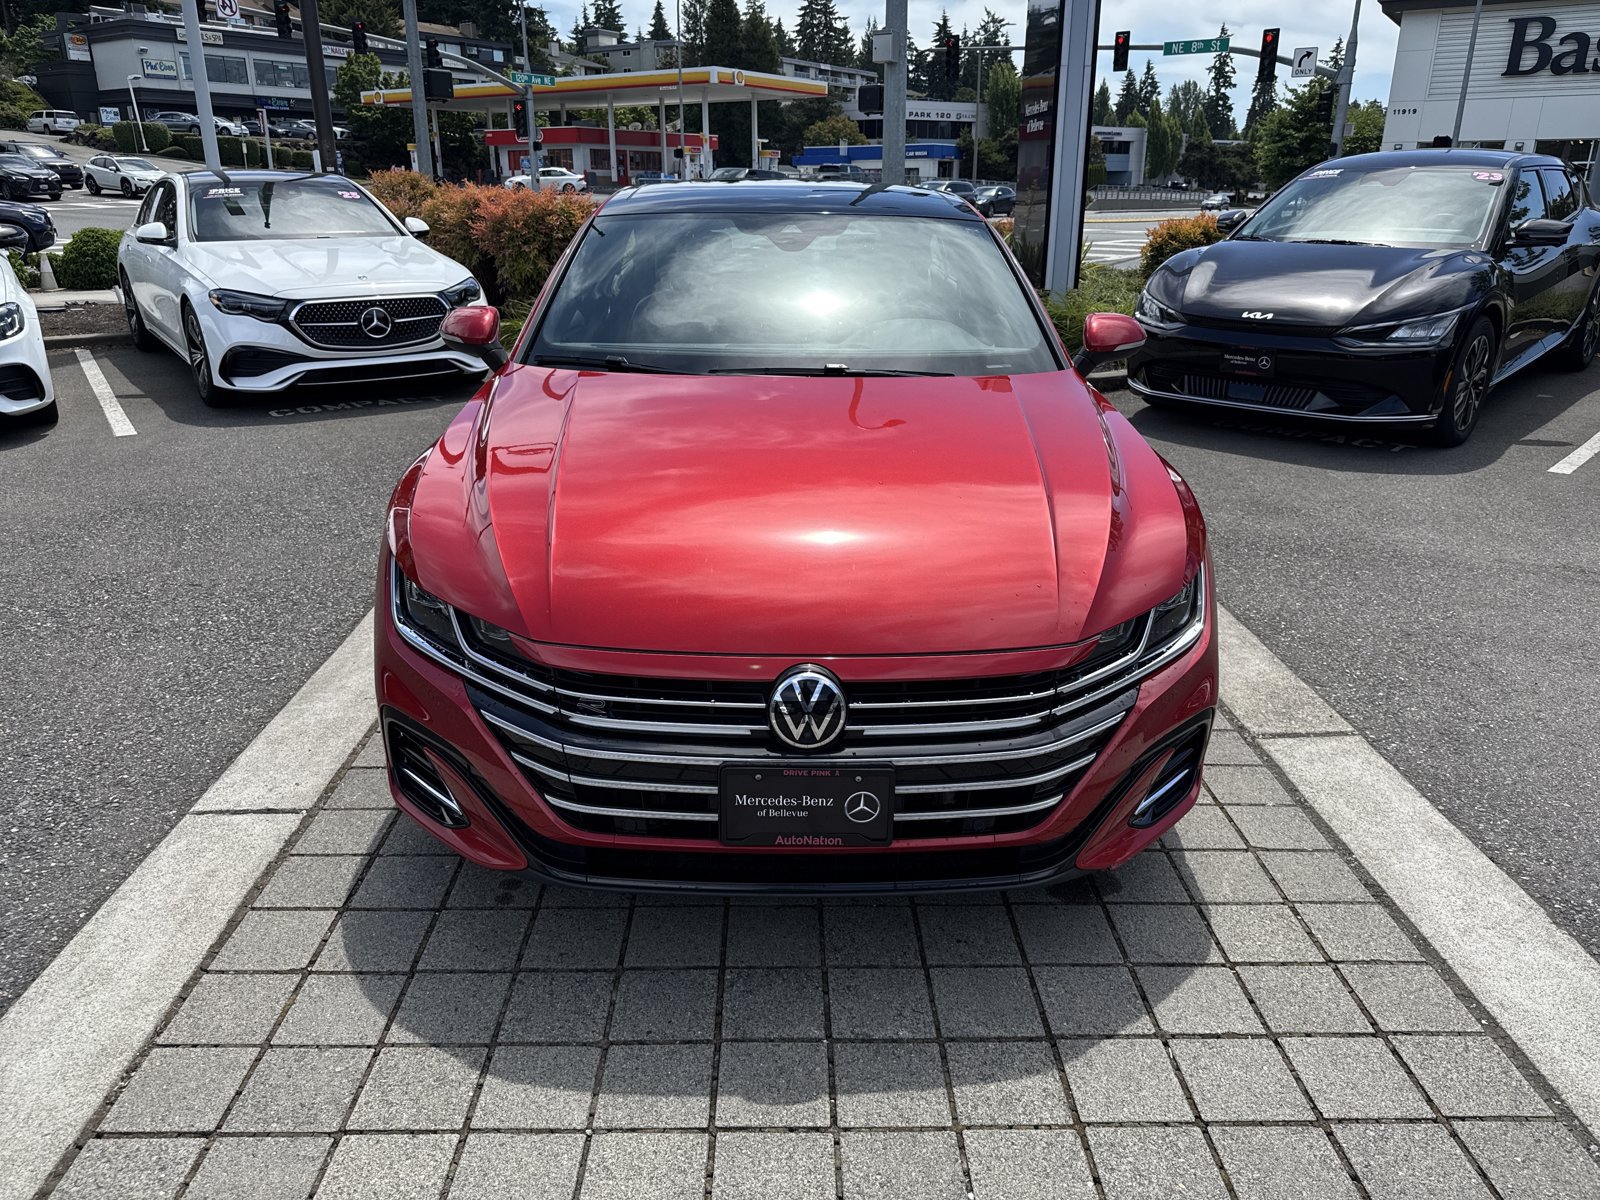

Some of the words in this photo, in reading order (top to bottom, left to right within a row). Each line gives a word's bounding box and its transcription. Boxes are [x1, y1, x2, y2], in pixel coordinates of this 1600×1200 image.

[331, 47, 345, 55] NAILS
[1172, 43, 1184, 54] NE
[1191, 42, 1204, 53] 8th
[1210, 40, 1221, 51] St
[515, 74, 528, 82] 120th
[531, 75, 541, 84] Ave
[544, 76, 552, 85] NE
[1472, 171, 1503, 181] '23
[1224, 353, 1256, 363] Mercedes-Benz
[268, 395, 443, 418] COMPACT
[735, 794, 834, 807] Mercedes-Benz
[757, 809, 767, 817] of
[769, 808, 809, 818] Bellevue
[775, 835, 843, 846] AutoNation
